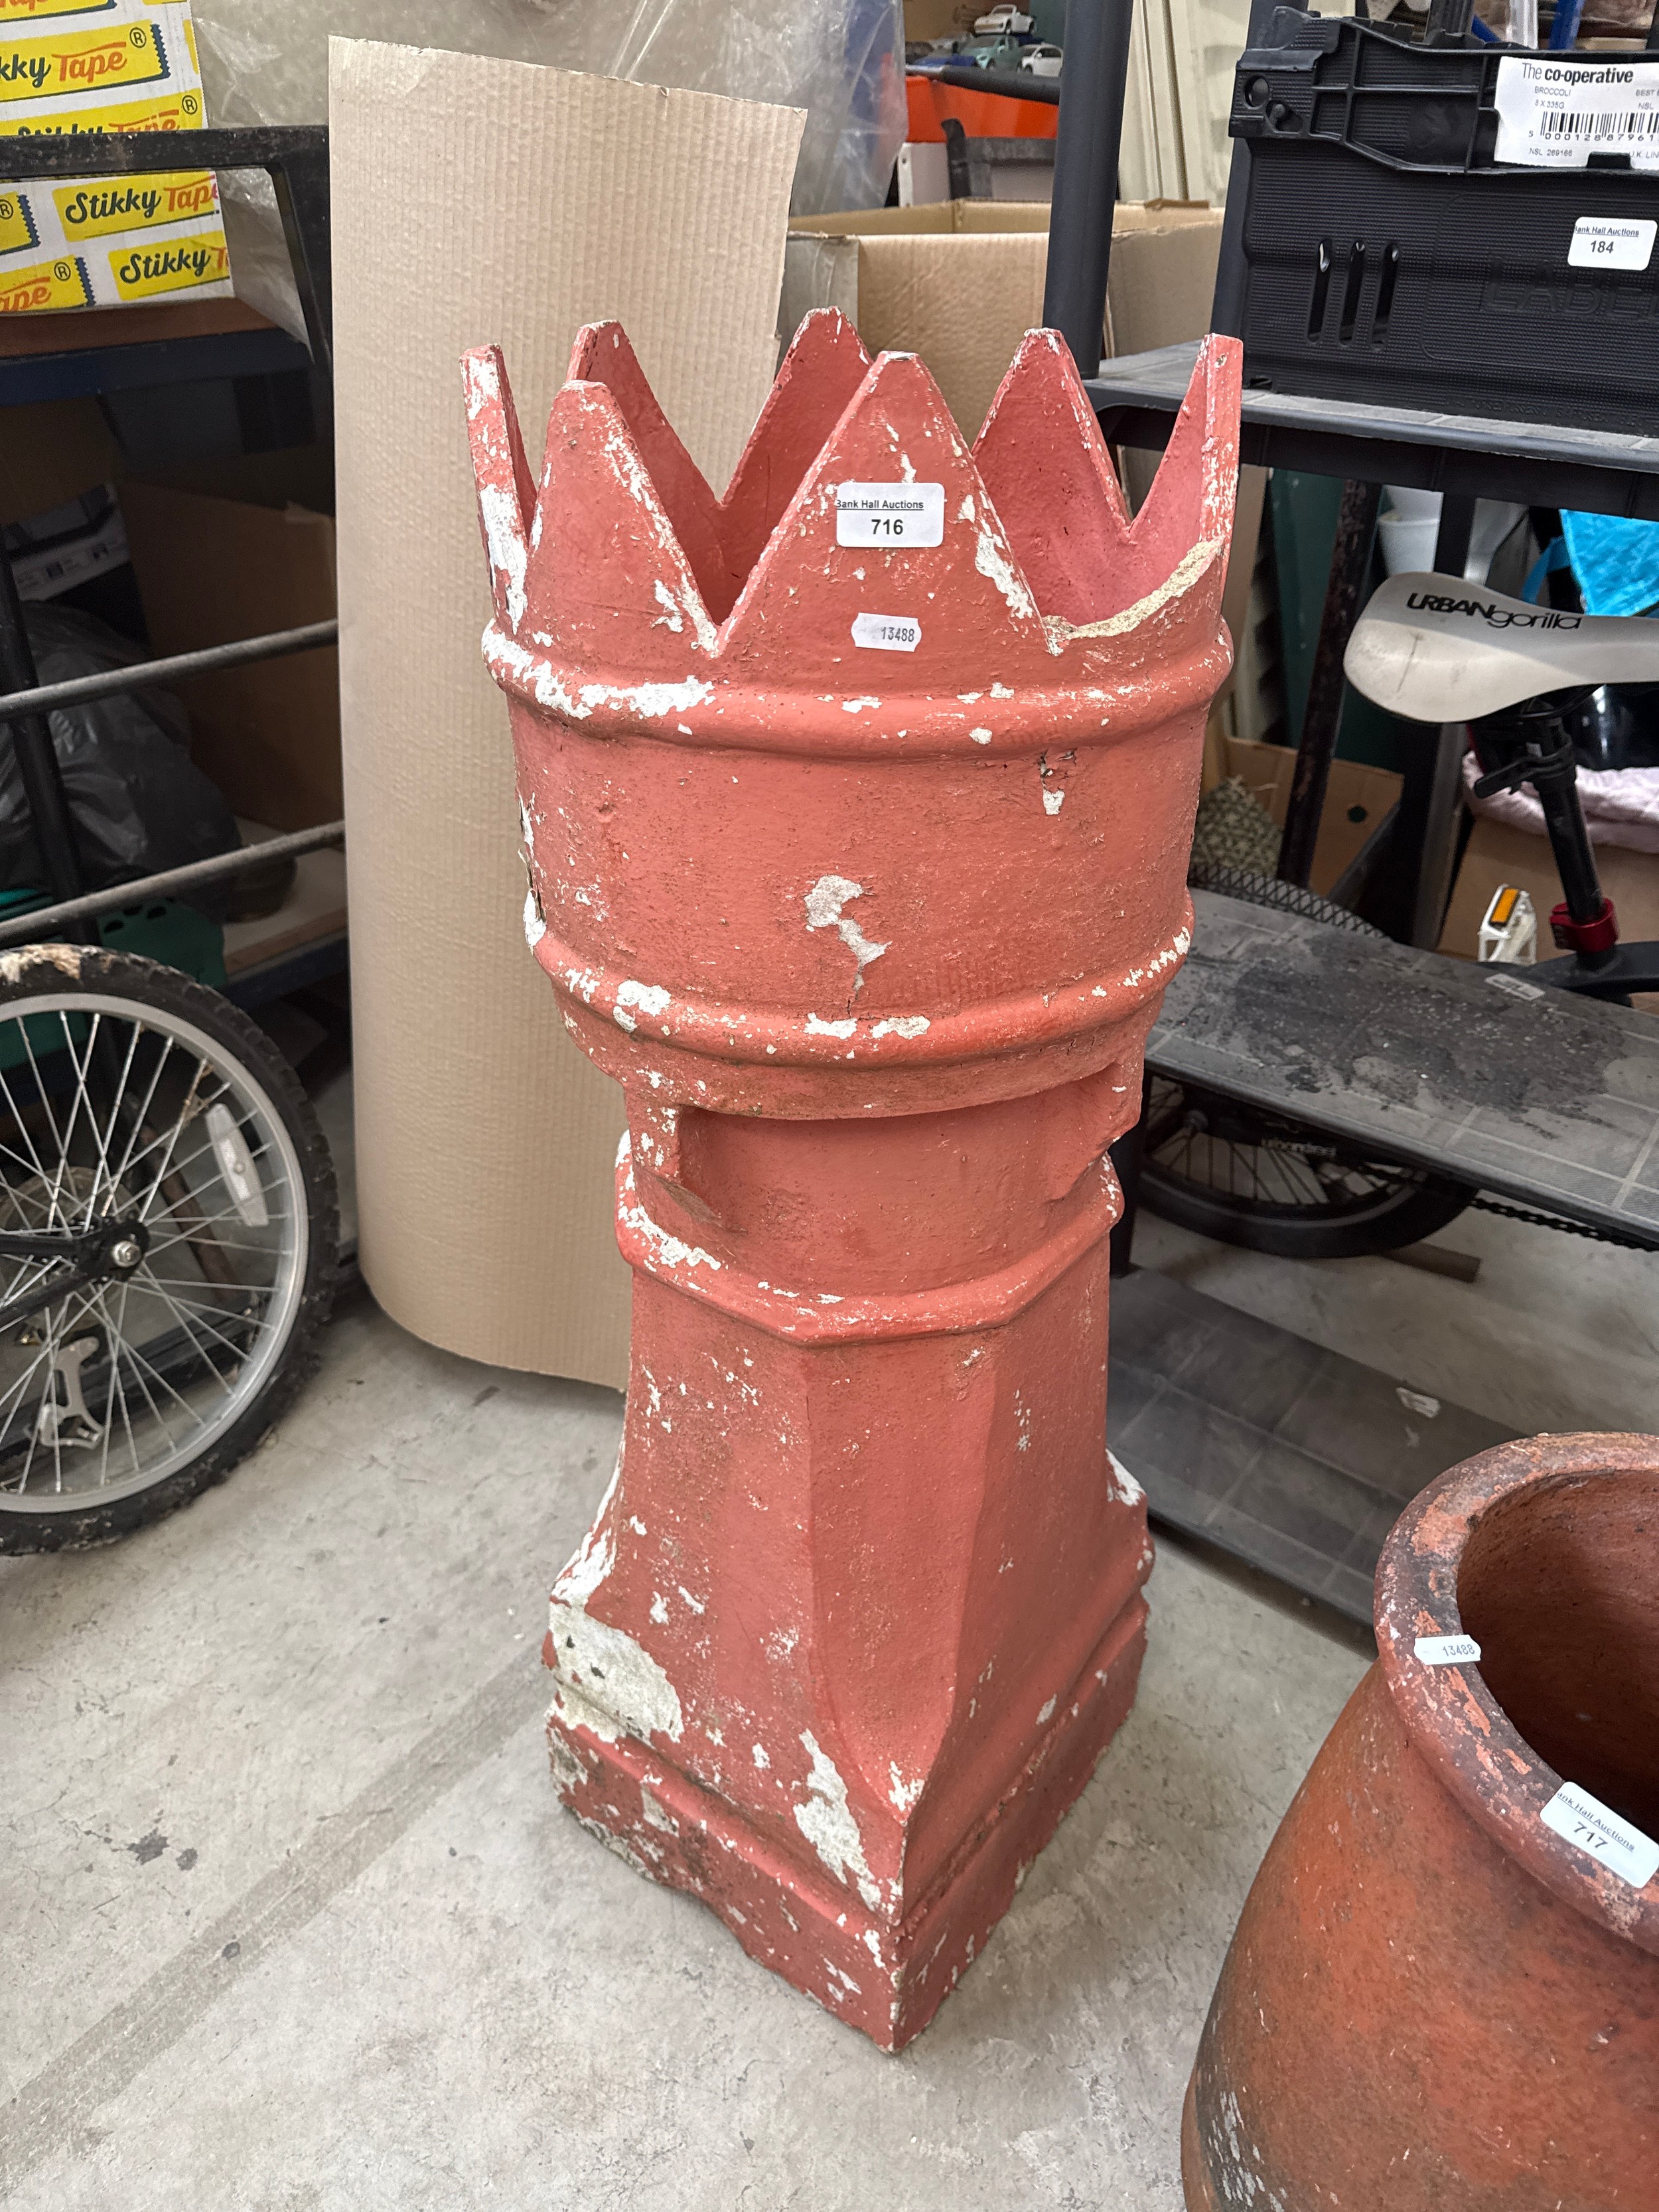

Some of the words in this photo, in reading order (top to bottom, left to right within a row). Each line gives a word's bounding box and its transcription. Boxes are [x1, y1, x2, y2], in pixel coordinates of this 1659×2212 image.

[52, 41, 127, 84] Tape
[1522, 62, 1542, 80] The
[1544, 68, 1634, 86] co-operative
[1534, 86, 1571, 97] BROCCOLI
[65, 188, 161, 224] Stikky
[1607, 227, 1639, 237] Auctions
[1591, 240, 1614, 254] 184
[119, 249, 211, 284] Stikky
[861, 500, 879, 509] Hall
[882, 500, 924, 509] Auctions
[871, 519, 903, 535] 716
[881, 627, 914, 642] 13488
[1443, 1644, 1475, 1657] 13488
[1573, 1821, 1608, 1848] 717
[1575, 1803, 1594, 1820] Hall
[1594, 1818, 1635, 1850] Auctions
